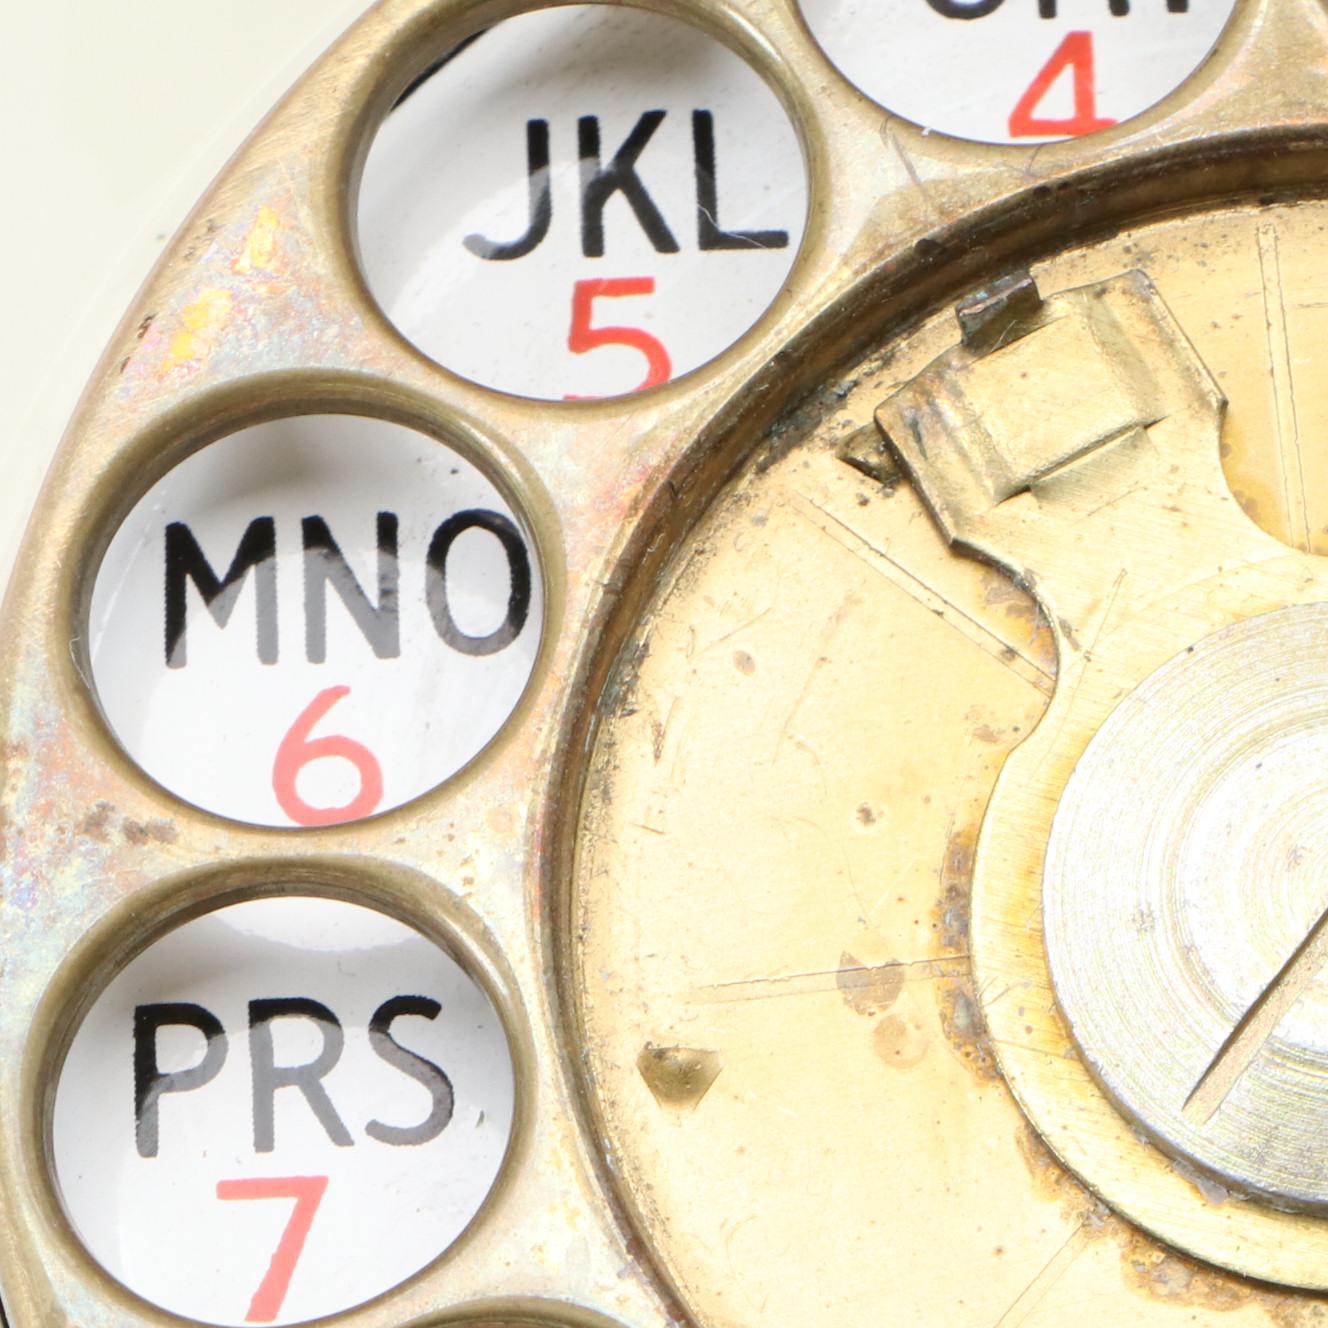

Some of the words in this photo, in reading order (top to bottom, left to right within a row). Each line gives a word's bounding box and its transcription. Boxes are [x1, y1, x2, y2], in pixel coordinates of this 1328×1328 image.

[1008, 30, 1117, 138] 4
[463, 108, 789, 262] JKL
[566, 278, 674, 400] 5
[164, 505, 532, 668] MNO
[273, 685, 384, 826] 6
[132, 993, 455, 1158] PRS
[217, 1175, 328, 1322] 7
